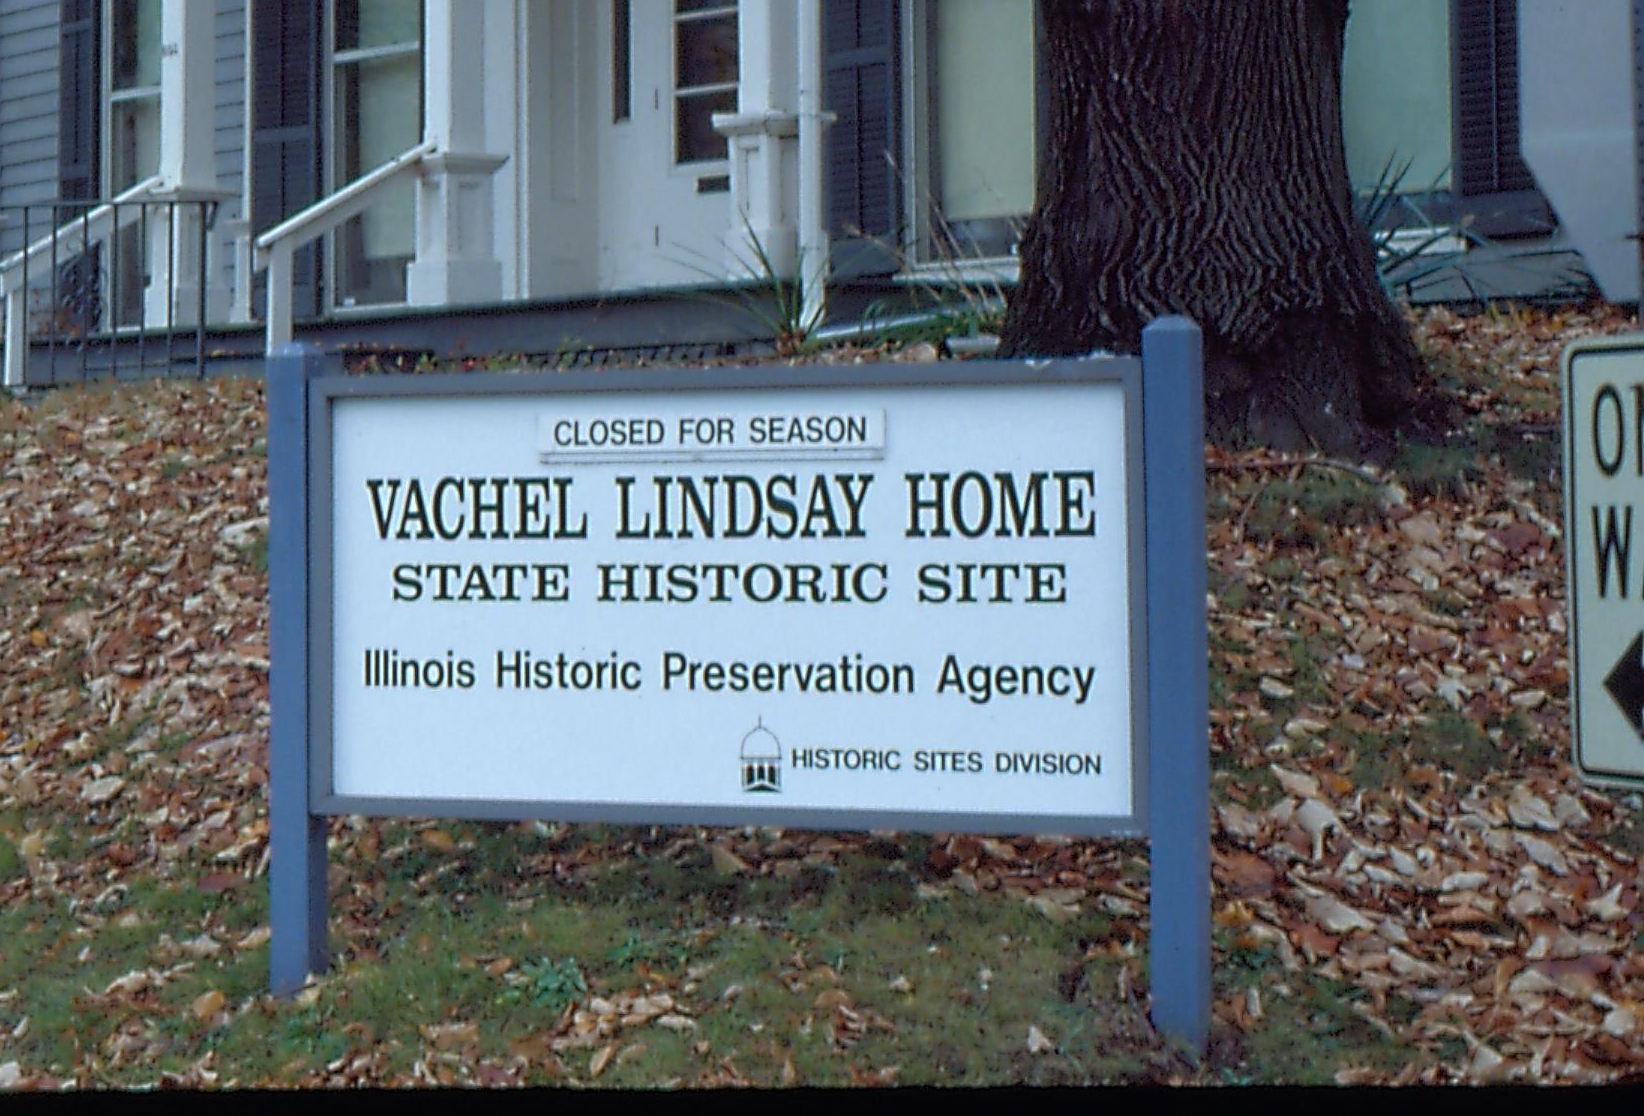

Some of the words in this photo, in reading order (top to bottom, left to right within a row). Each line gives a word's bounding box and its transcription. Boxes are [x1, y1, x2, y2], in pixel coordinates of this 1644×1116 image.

[554, 419, 665, 447] CLOSED
[679, 417, 735, 445] FOR
[749, 416, 867, 445] SEASON
[366, 476, 588, 541] VACHEL
[615, 473, 875, 540] LINDSAY
[904, 470, 1096, 539] HOME
[1592, 504, 1644, 600] W
[392, 563, 569, 602] STATE
[596, 562, 888, 604] HISTORIC
[918, 563, 1067, 604] SITE
[364, 649, 476, 689] Illinois
[497, 650, 642, 691] Historic
[663, 651, 915, 694] Preservation
[937, 654, 1096, 705] Agency
[792, 748, 901, 771] HISTORIC
[914, 750, 983, 773] SITES
[995, 752, 1102, 775] DIVISION
